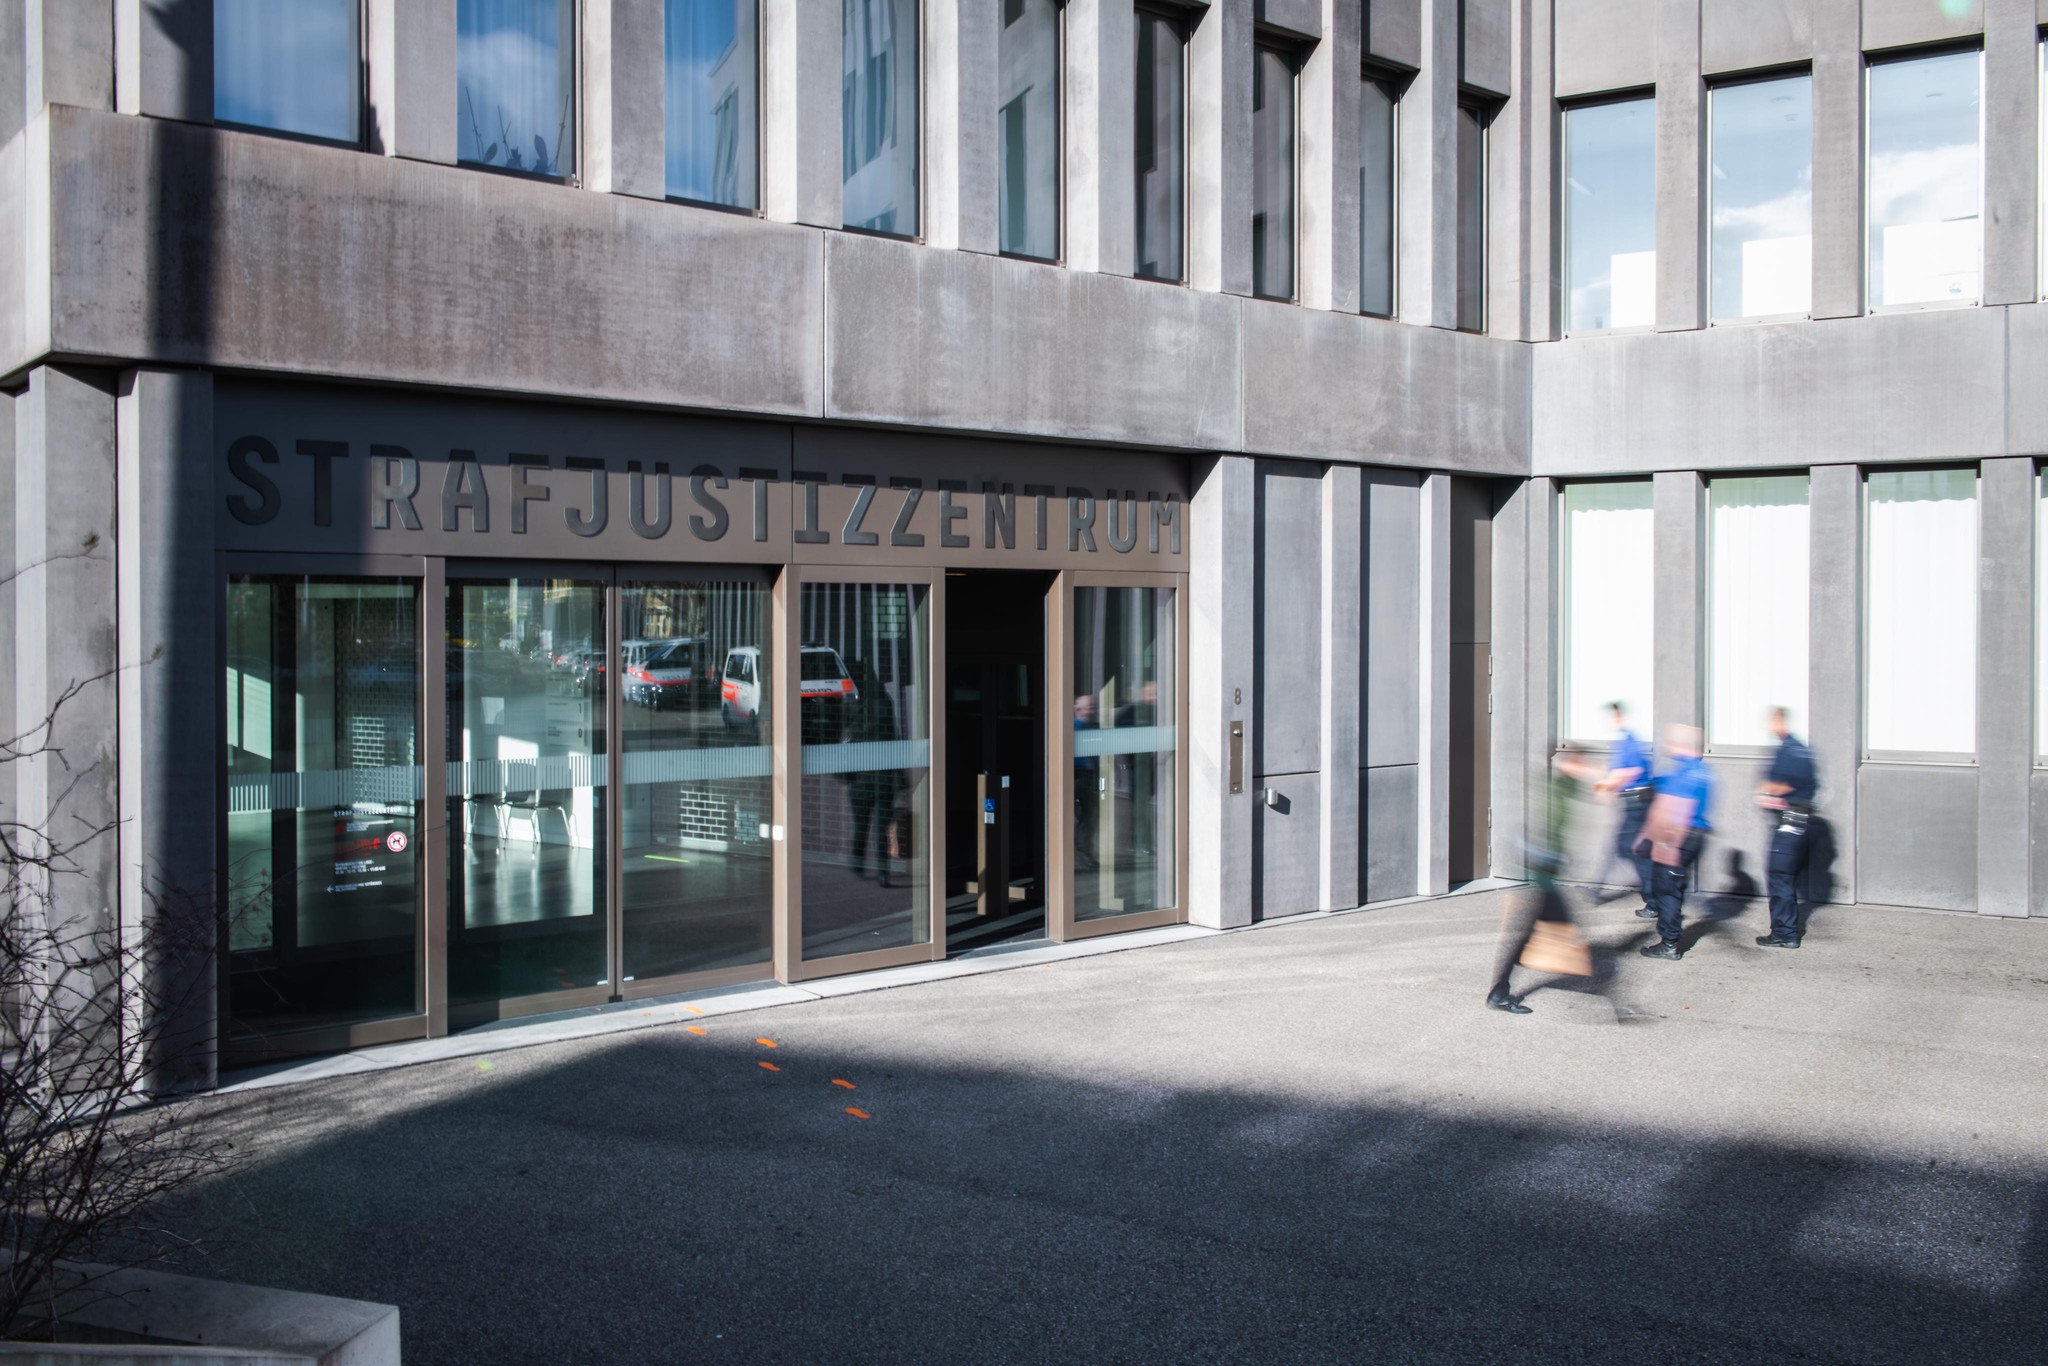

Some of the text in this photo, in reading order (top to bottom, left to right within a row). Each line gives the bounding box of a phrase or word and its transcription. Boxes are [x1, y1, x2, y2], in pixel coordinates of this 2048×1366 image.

[226, 435, 1183, 555] STRAFJUSTIZZENTRUM
[1234, 688, 1242, 705] 8
[333, 805, 402, 816] STRAFJSTIZZENTRUM
